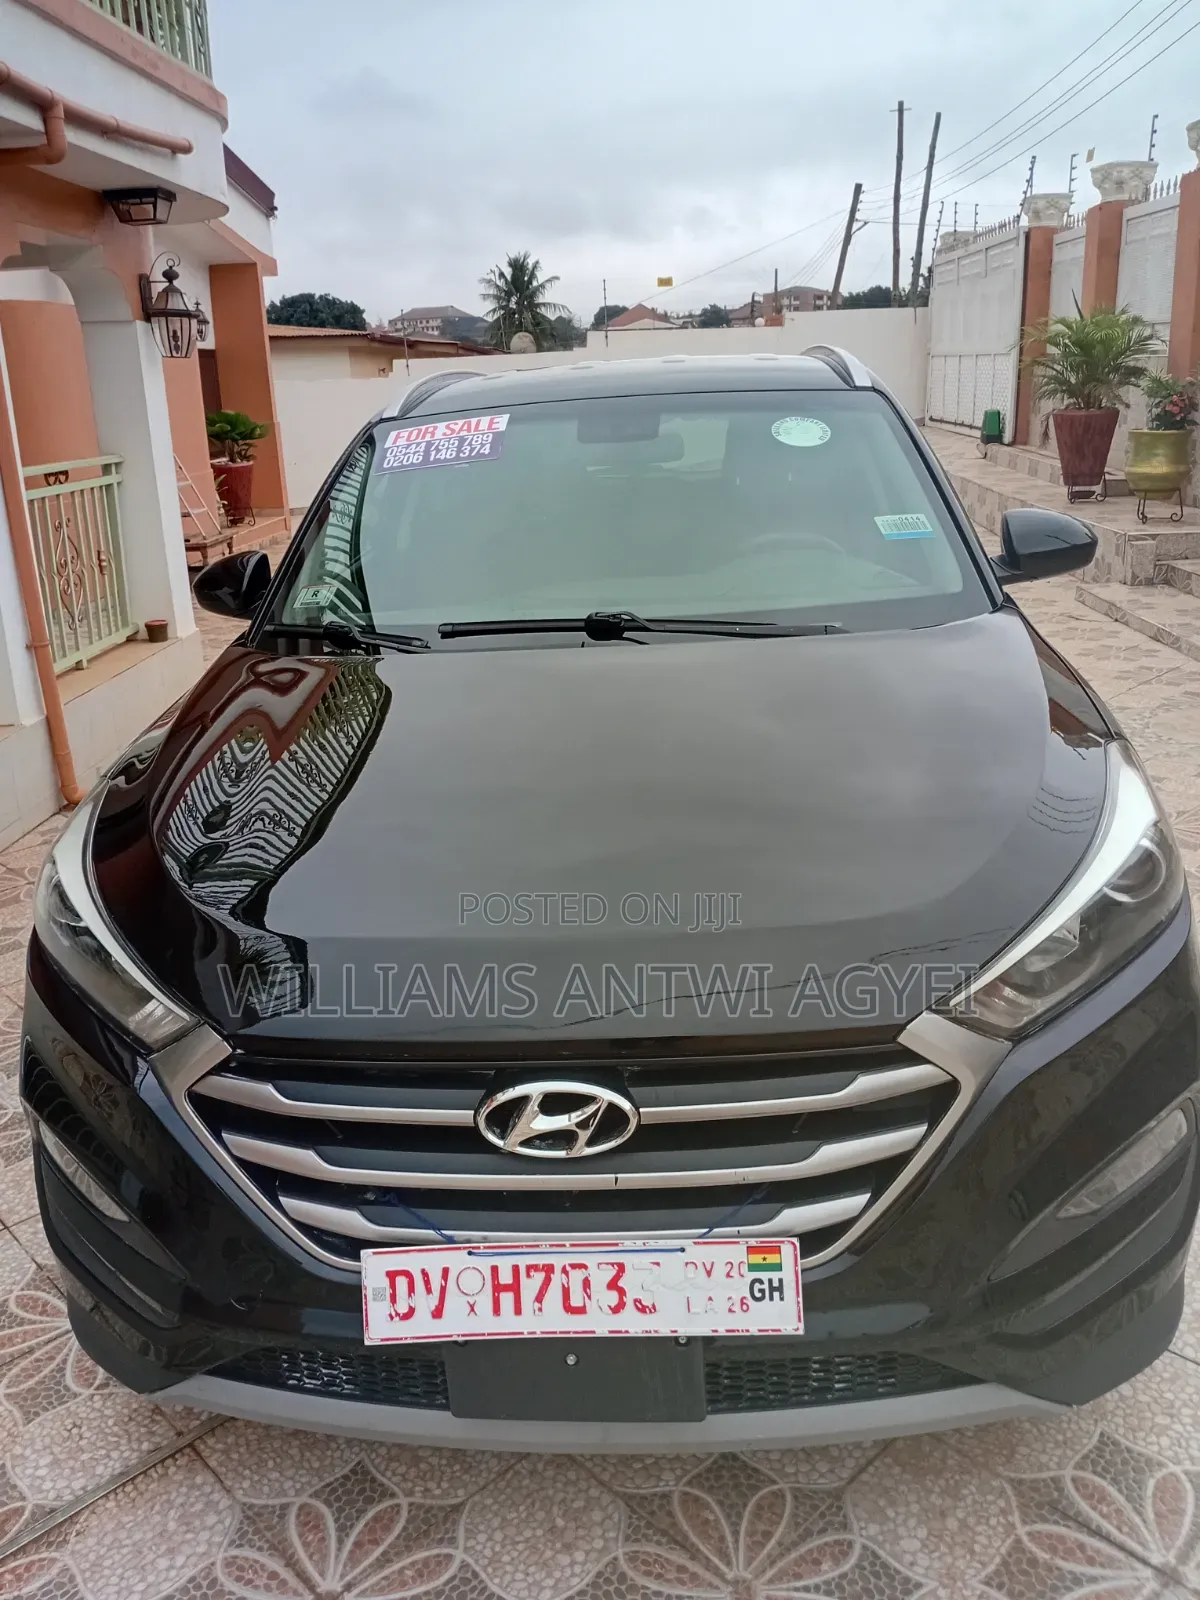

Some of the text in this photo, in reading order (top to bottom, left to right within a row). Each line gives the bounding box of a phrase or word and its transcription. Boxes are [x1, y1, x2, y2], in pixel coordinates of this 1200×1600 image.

[392, 416, 503, 445] FOR SALE
[383, 444, 491, 468] 0206 146 374
[386, 433, 492, 457] 0544 755 789
[311, 590, 320, 598] R
[385, 1266, 450, 1321] DV
[750, 1278, 785, 1302] GH
[727, 1296, 750, 1313] 26
